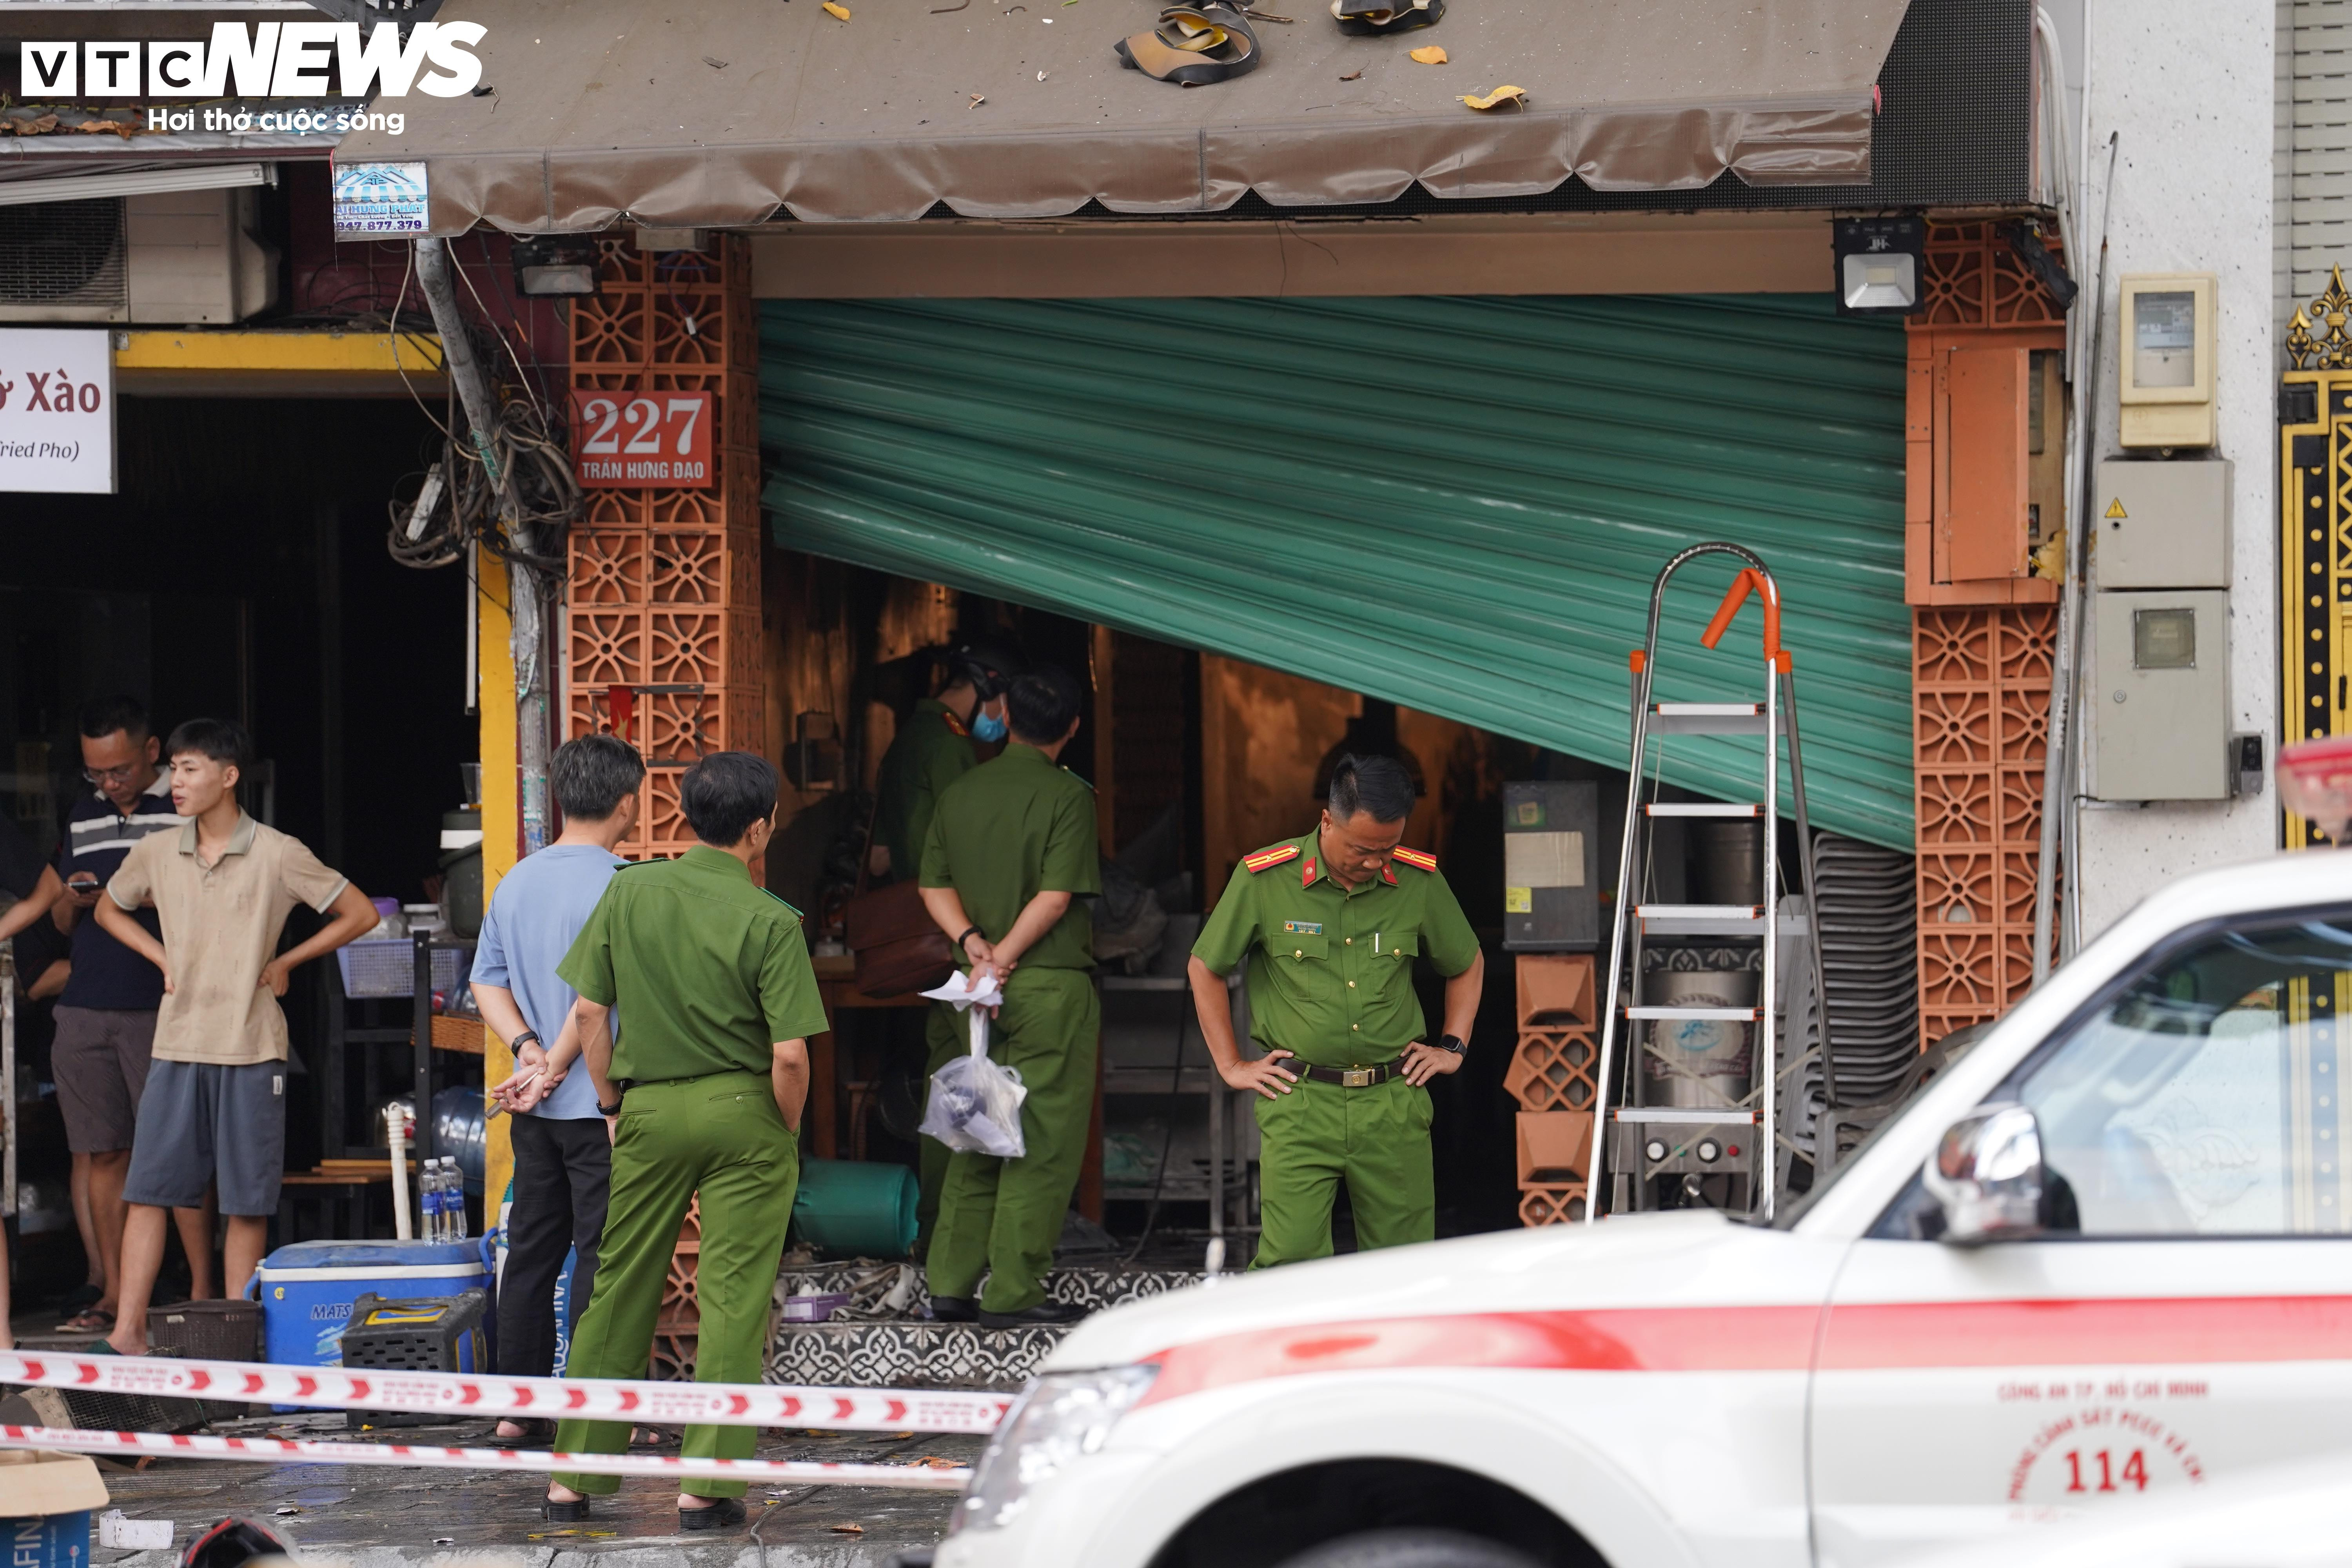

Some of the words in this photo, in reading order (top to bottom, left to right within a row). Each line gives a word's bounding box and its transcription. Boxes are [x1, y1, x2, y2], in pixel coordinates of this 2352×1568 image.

[336, 220, 422, 230] 947.877.379
[26, 368, 101, 413] Xào
[582, 398, 703, 455] 227
[0, 440, 35, 457] ried
[39, 440, 79, 463] Pho)
[673, 461, 704, 483] ĐẠO
[310, 1303, 354, 1321] MATS
[2063, 1448, 2149, 1493] 114
